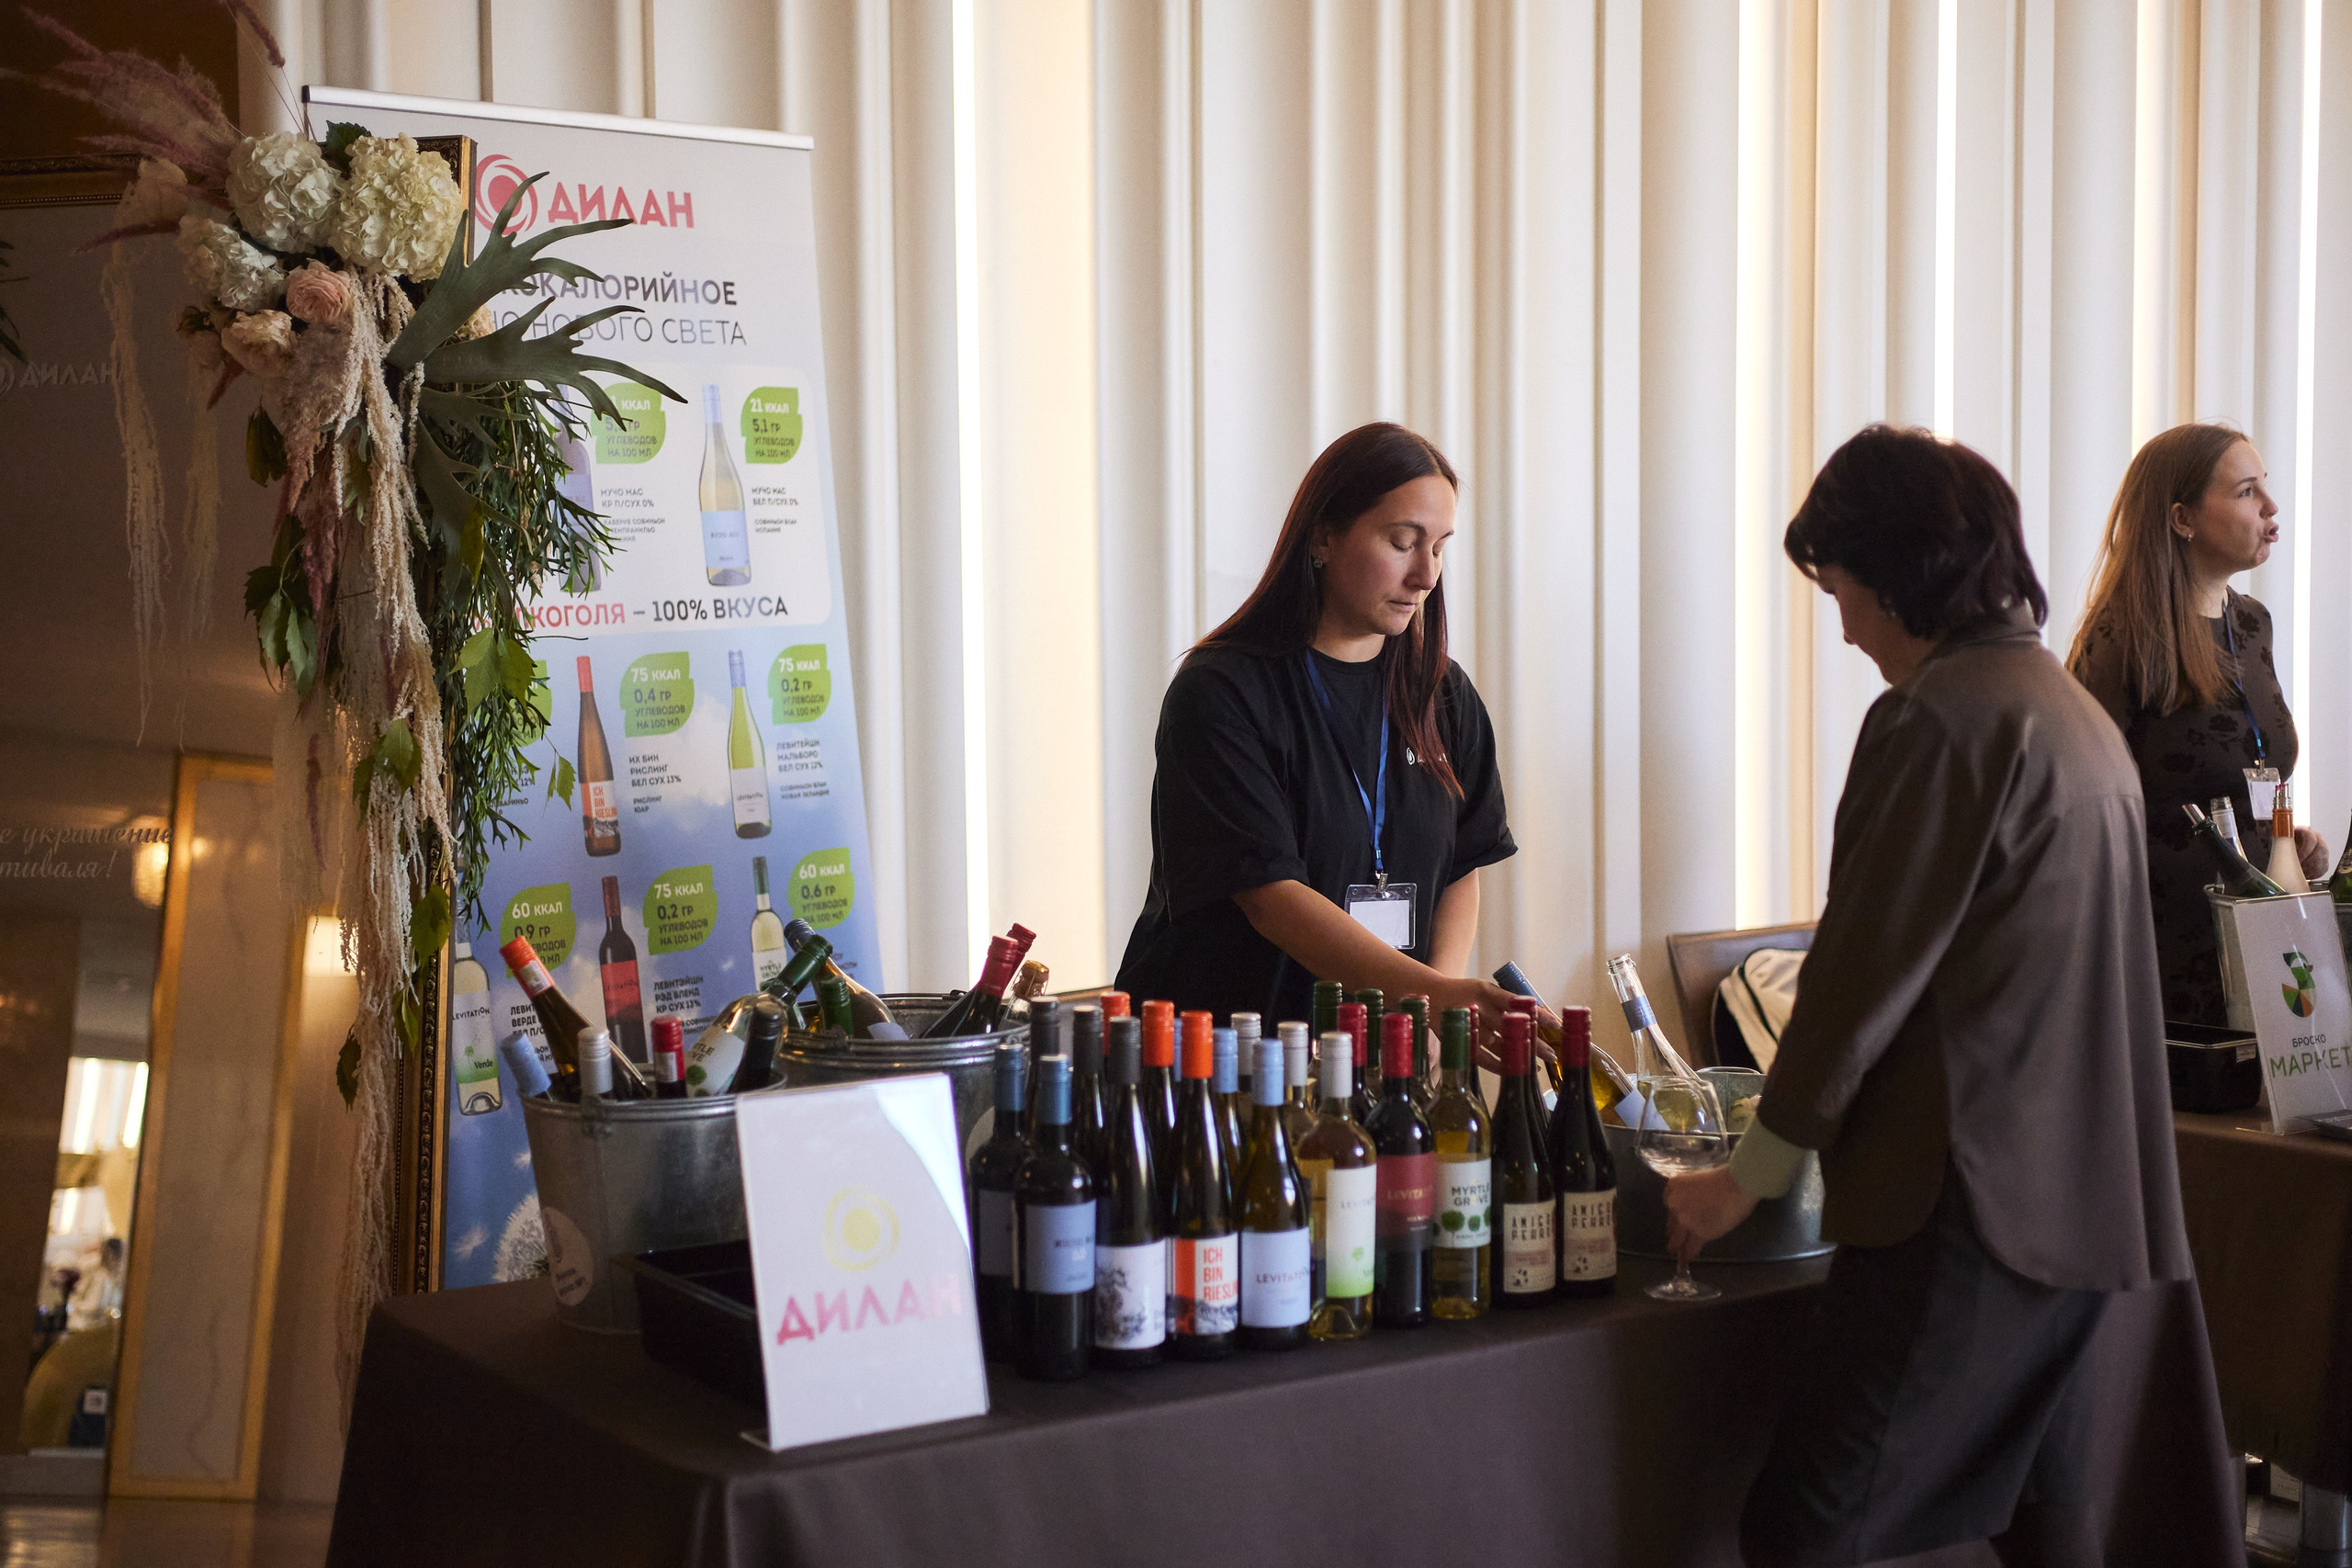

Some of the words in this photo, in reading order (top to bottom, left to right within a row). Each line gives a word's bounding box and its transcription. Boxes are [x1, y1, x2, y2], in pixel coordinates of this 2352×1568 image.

[548, 182, 695, 229] ДИЛАН
[502, 271, 738, 306] ОКАЛОРИЙНОЕ
[662, 319, 747, 345] СВЕТА
[622, 399, 650, 411] ККАЛ
[750, 397, 763, 412] 21
[752, 418, 768, 433] 5,1
[606, 435, 658, 446] УГЛЕВОДОВ
[754, 436, 796, 446] УГЛЕВОДОВ
[607, 448, 619, 457] НА
[622, 448, 637, 457] 100
[639, 447, 651, 457] МЛ
[601, 488, 624, 497] МУЧО
[626, 488, 644, 497] МАС
[752, 487, 772, 495] МУЧО
[773, 487, 787, 495] МАС
[602, 500, 613, 508] КР
[615, 499, 641, 508] П/СУХ
[642, 499, 654, 508] 0%
[515, 603, 626, 629] ЛКОГОЛЯ
[652, 599, 707, 622] 100%
[713, 595, 788, 620] ВКУСА
[778, 657, 795, 673] 75
[797, 660, 820, 671] ККАЛ
[631, 667, 649, 683] 75
[651, 669, 681, 681] ККАЛ
[781, 678, 800, 693] 0,2
[634, 688, 656, 705] 0,4
[635, 705, 686, 716] УГЛЕВОДОВ
[637, 720, 649, 729] НА
[650, 718, 665, 728] 100
[667, 717, 680, 727] МЛ
[628, 756, 640, 764] ИХ
[642, 754, 660, 763] БИН
[777, 750, 819, 761] МАЛЬБОРО
[630, 764, 669, 776] РИСЛИНГ
[778, 763, 793, 773] БЕЛ
[631, 778, 648, 788] БЕЛ
[649, 776, 665, 786] СУХ
[23, 826, 174, 856] украшение
[0, 849, 118, 880] тиваля!
[798, 863, 818, 880] 60
[819, 863, 845, 877] ККАЛ
[653, 883, 672, 900] 75
[674, 882, 704, 897] ККАЛ
[801, 883, 822, 899] 0,6
[512, 902, 530, 919] 60
[534, 901, 562, 917] ККАЛ
[657, 903, 679, 921] 0,2
[658, 918, 708, 935] УГЛЕВОДОВ
[659, 936, 673, 947] НА
[674, 933, 689, 945] 100
[690, 931, 703, 943] МЛ
[548, 953, 560, 964] МЛ
[655, 991, 673, 1003] РЭД
[673, 987, 701, 1000] БЛЕНД
[656, 1003, 668, 1014] КР
[669, 1000, 685, 1012] СУХ
[511, 1017, 537, 1028] ВЕРДЕ
[2292, 1033, 2327, 1048] БРОСКО
[474, 1058, 494, 1070] Verde
[2269, 1045, 2351, 1077] МАРКЕТ
[1204, 1247, 1223, 1264] ICH
[1204, 1266, 1224, 1283] BIN
[776, 1271, 963, 1347] ДИЛАН
